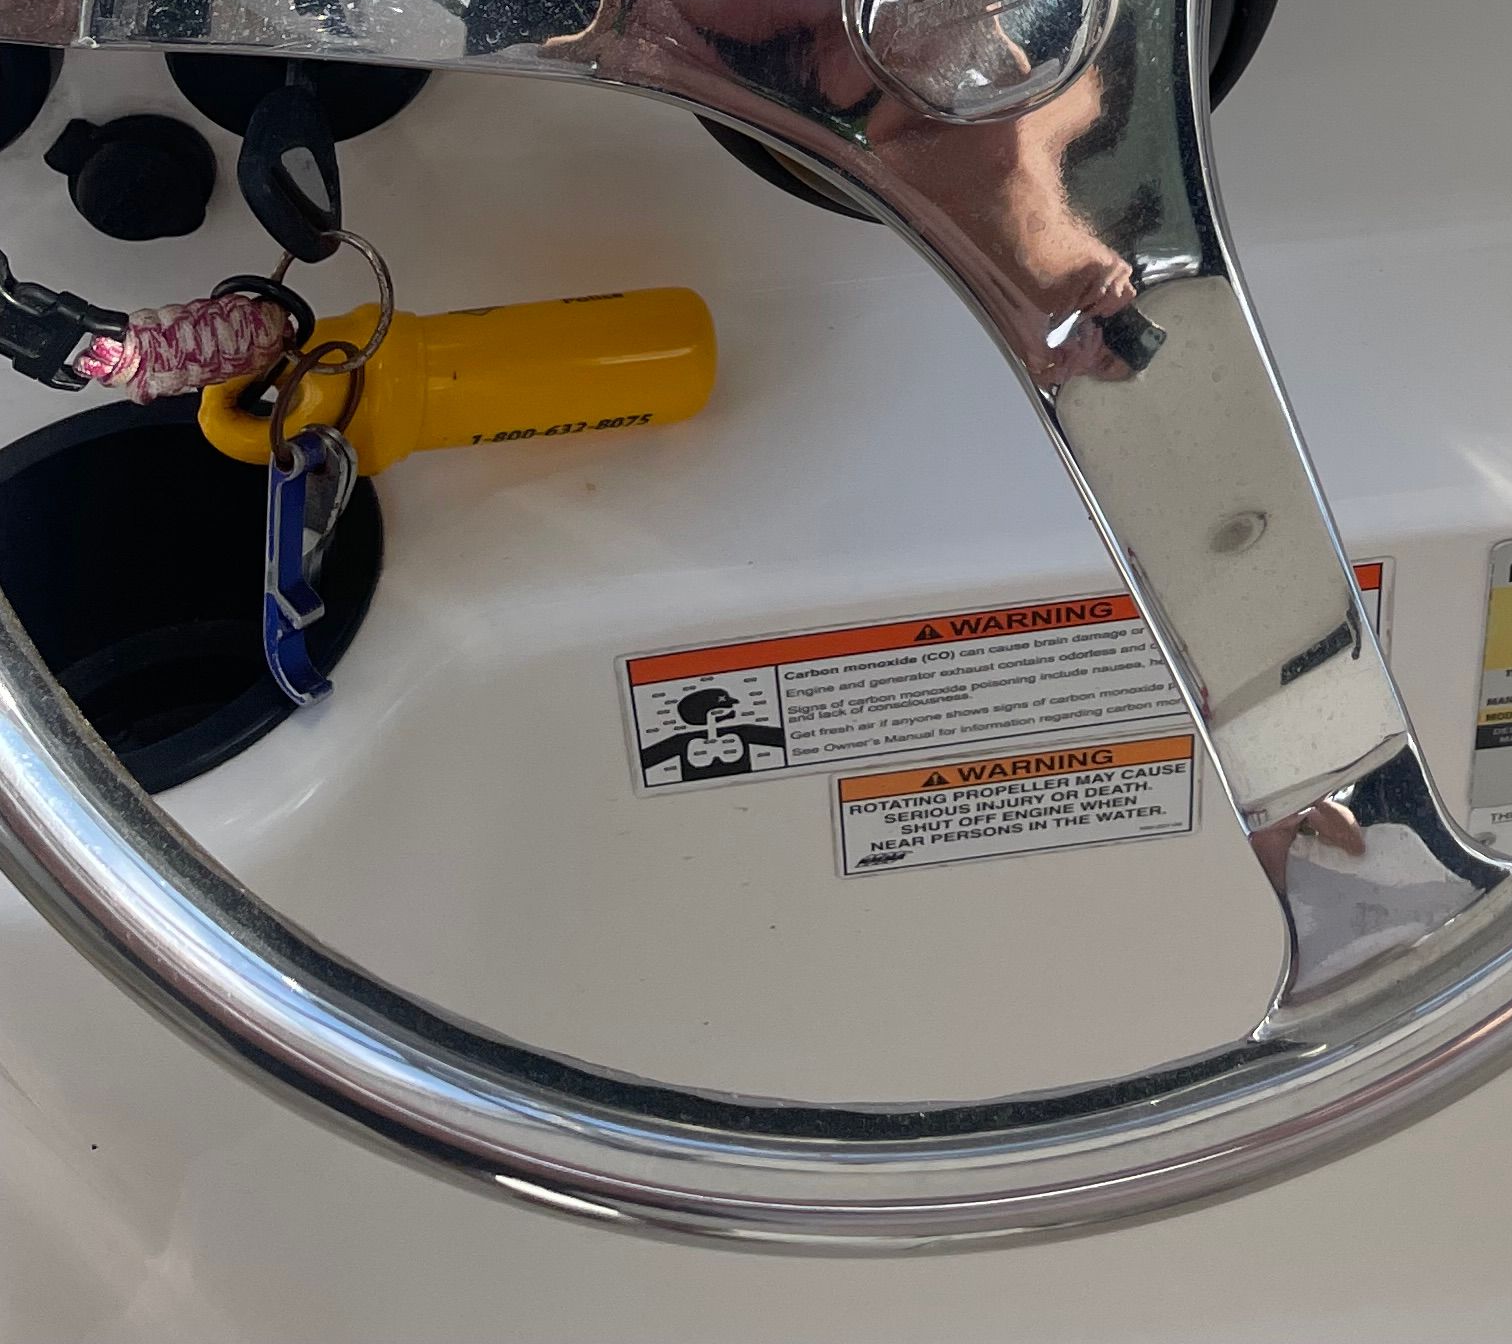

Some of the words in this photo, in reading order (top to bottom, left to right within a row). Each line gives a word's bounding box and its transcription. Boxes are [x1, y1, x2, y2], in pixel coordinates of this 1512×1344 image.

[471, 413, 653, 445] 1-800-632-8075
[950, 601, 1113, 636] WARNING
[784, 666, 839, 681] Carbon
[843, 655, 917, 672] monoxide
[922, 650, 956, 665] (CO)
[959, 646, 985, 658] can
[988, 642, 1030, 654] cause
[1034, 636, 1068, 649] brain
[1072, 629, 1127, 644] damage
[1131, 627, 1145, 636] or
[786, 684, 835, 698] Engine
[839, 679, 865, 691] and
[869, 671, 936, 688] generator
[940, 663, 995, 678] exhaust
[998, 655, 1055, 670] contains
[1058, 646, 1116, 662] odorless
[1120, 643, 1146, 654] and
[788, 702, 827, 715] Signs
[831, 699, 845, 710] of
[848, 694, 896, 707] carbon
[900, 684, 967, 700] monoxide
[971, 673, 1036, 694] poisoning
[1040, 666, 1088, 680] include
[788, 712, 815, 723] and
[818, 709, 847, 720] lack
[850, 704, 864, 715] of
[790, 729, 816, 740] Get
[819, 724, 854, 737] fresh
[858, 720, 875, 731] air
[879, 719, 888, 728] if
[892, 712, 942, 728] anyone
[946, 706, 989, 719] shows
[993, 700, 1028, 713] signs
[1032, 697, 1046, 707] of
[1050, 691, 1095, 705] carbon
[1099, 682, 1164, 698] monoxide
[792, 746, 819, 757] See
[823, 736, 880, 753] Owner's
[884, 729, 935, 744] Manual
[939, 726, 956, 737] for
[960, 716, 1035, 734] information
[1039, 706, 1103, 724] regarding
[1106, 699, 1152, 714] carbon
[849, 793, 947, 816] ROTATING
[953, 776, 1069, 802] PROPELLER
[1076, 771, 1114, 786] MAY
[1121, 762, 1187, 781] CAUSE
[957, 748, 1114, 783] WARNING
[884, 804, 971, 825] SERIOUS
[976, 794, 1045, 813] INJURY
[1050, 787, 1080, 803] OR
[1085, 780, 1153, 798] DEATH.
[901, 819, 952, 836] SHUT
[958, 813, 997, 829] OFF
[1003, 804, 1075, 823] ENGINE
[1082, 795, 1138, 812] WHEN
[870, 835, 925, 853] NEAR
[931, 823, 1024, 845] PERSONS
[1029, 819, 1048, 832] IN
[1053, 812, 1091, 827] THE
[1094, 805, 1167, 824] WATER.
